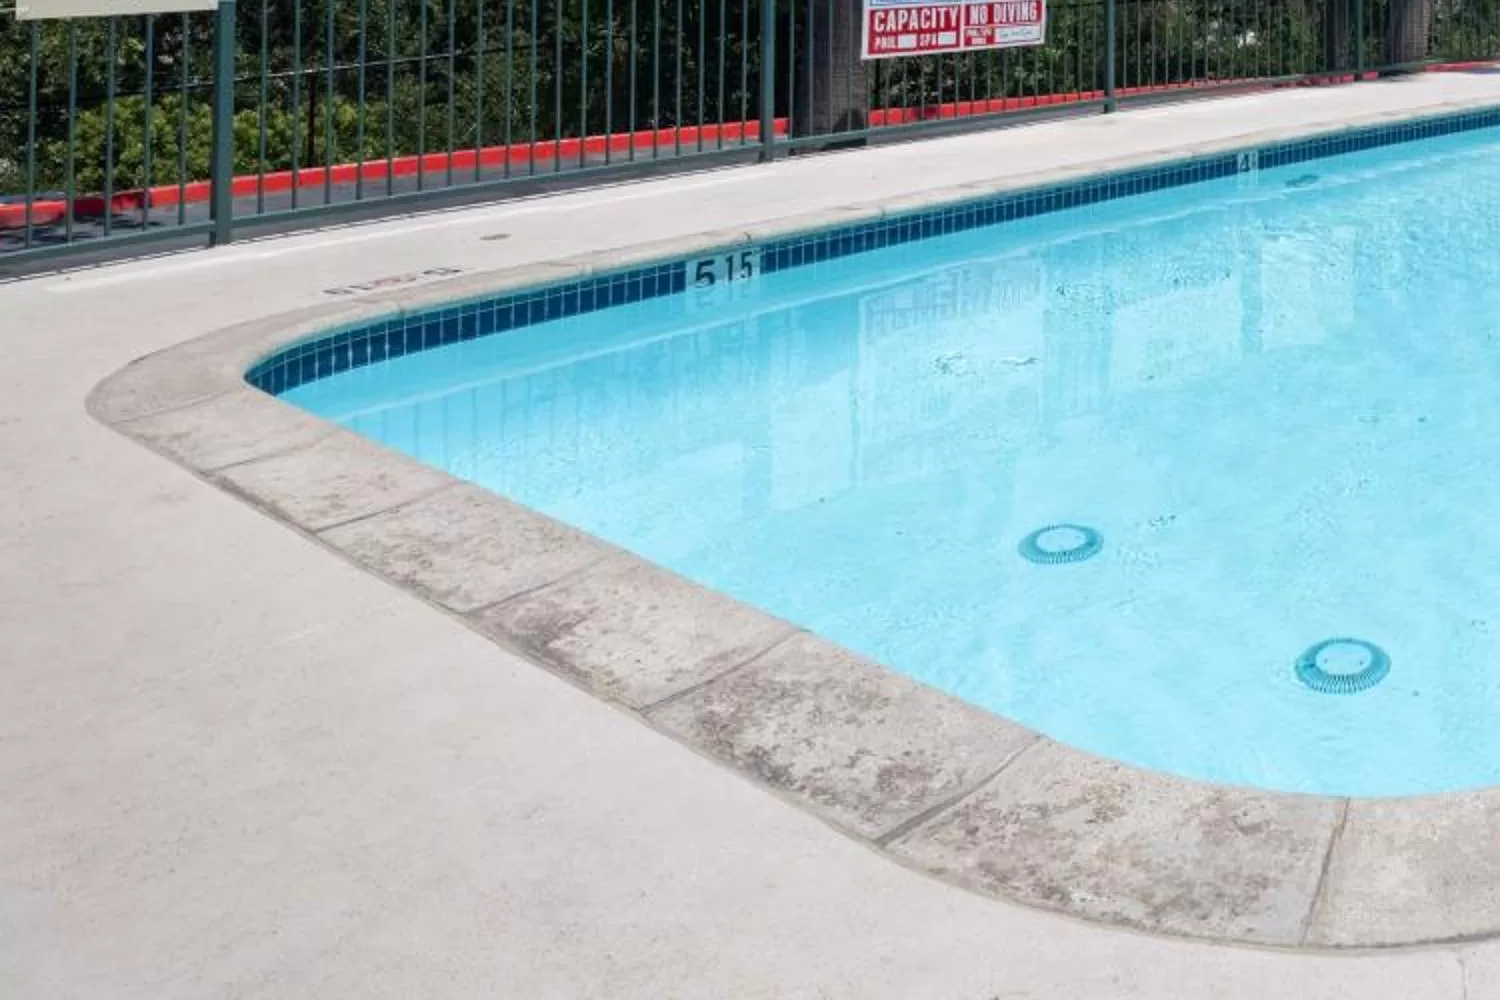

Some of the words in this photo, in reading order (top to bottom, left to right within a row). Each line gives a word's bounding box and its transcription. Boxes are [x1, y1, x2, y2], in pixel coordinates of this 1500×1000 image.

[873, 5, 959, 33] CAPACITY
[970, 5, 989, 26] NO
[993, 1, 1038, 24] DIVING
